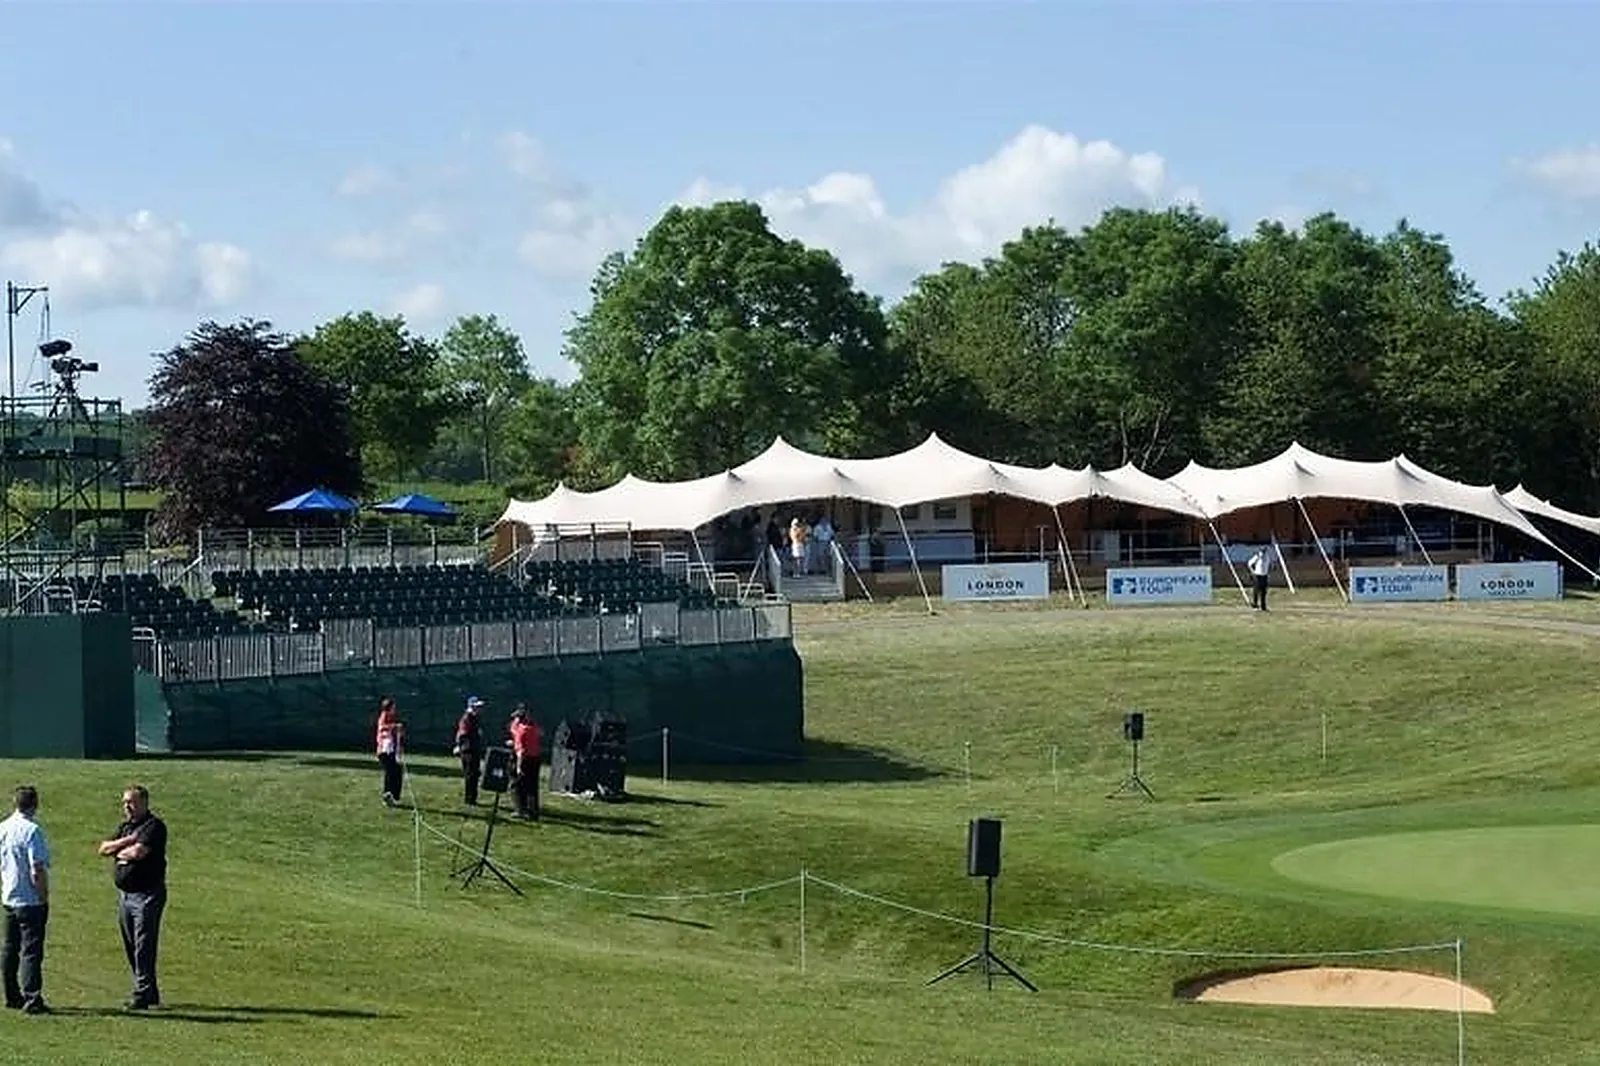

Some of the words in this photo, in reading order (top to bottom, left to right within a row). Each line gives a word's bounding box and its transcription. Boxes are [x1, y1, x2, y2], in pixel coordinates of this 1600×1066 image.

[1139, 576, 1207, 585] EUROPEAN
[1380, 573, 1444, 583] EUROPEAN
[967, 580, 1024, 591] LONDON
[1381, 584, 1413, 593] TOUR
[1480, 579, 1535, 589] LONDON
[1140, 585, 1173, 594] TOUR
